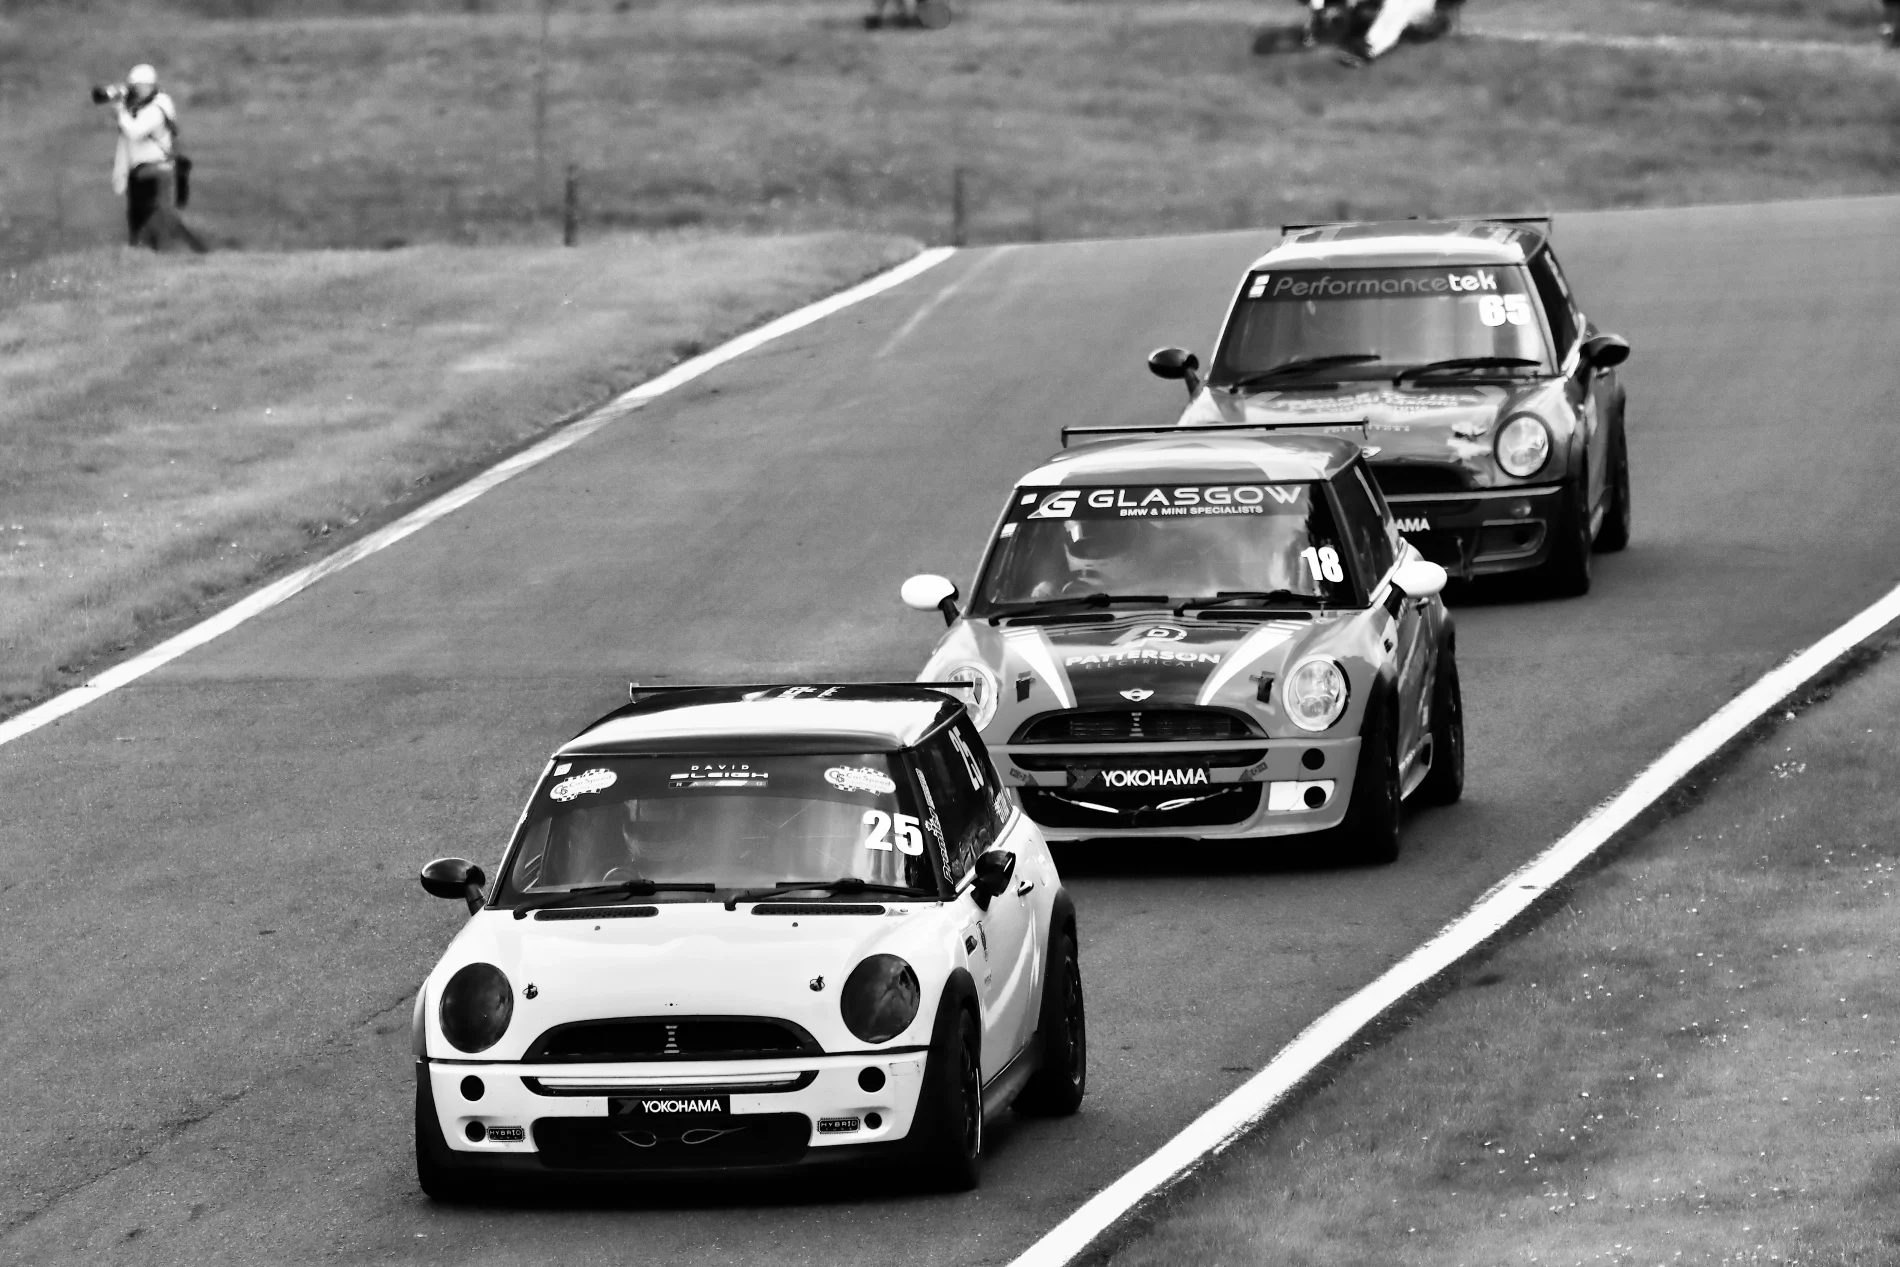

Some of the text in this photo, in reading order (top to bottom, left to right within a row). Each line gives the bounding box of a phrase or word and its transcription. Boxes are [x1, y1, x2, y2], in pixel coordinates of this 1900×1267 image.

[1478, 294, 1531, 327] 65
[1088, 486, 1301, 508] GLASGOW
[1120, 505, 1264, 517] BMW & MINI SPECIALISTS
[1301, 546, 1345, 583] 18
[1065, 649, 1222, 667] PATTERSON
[1101, 767, 1209, 788] YOKOHAMA
[862, 809, 924, 856] 25
[641, 1098, 722, 1114] YOKOHAMA
[489, 1129, 522, 1137] HYBRID
[820, 1120, 858, 1128] HYBRID
